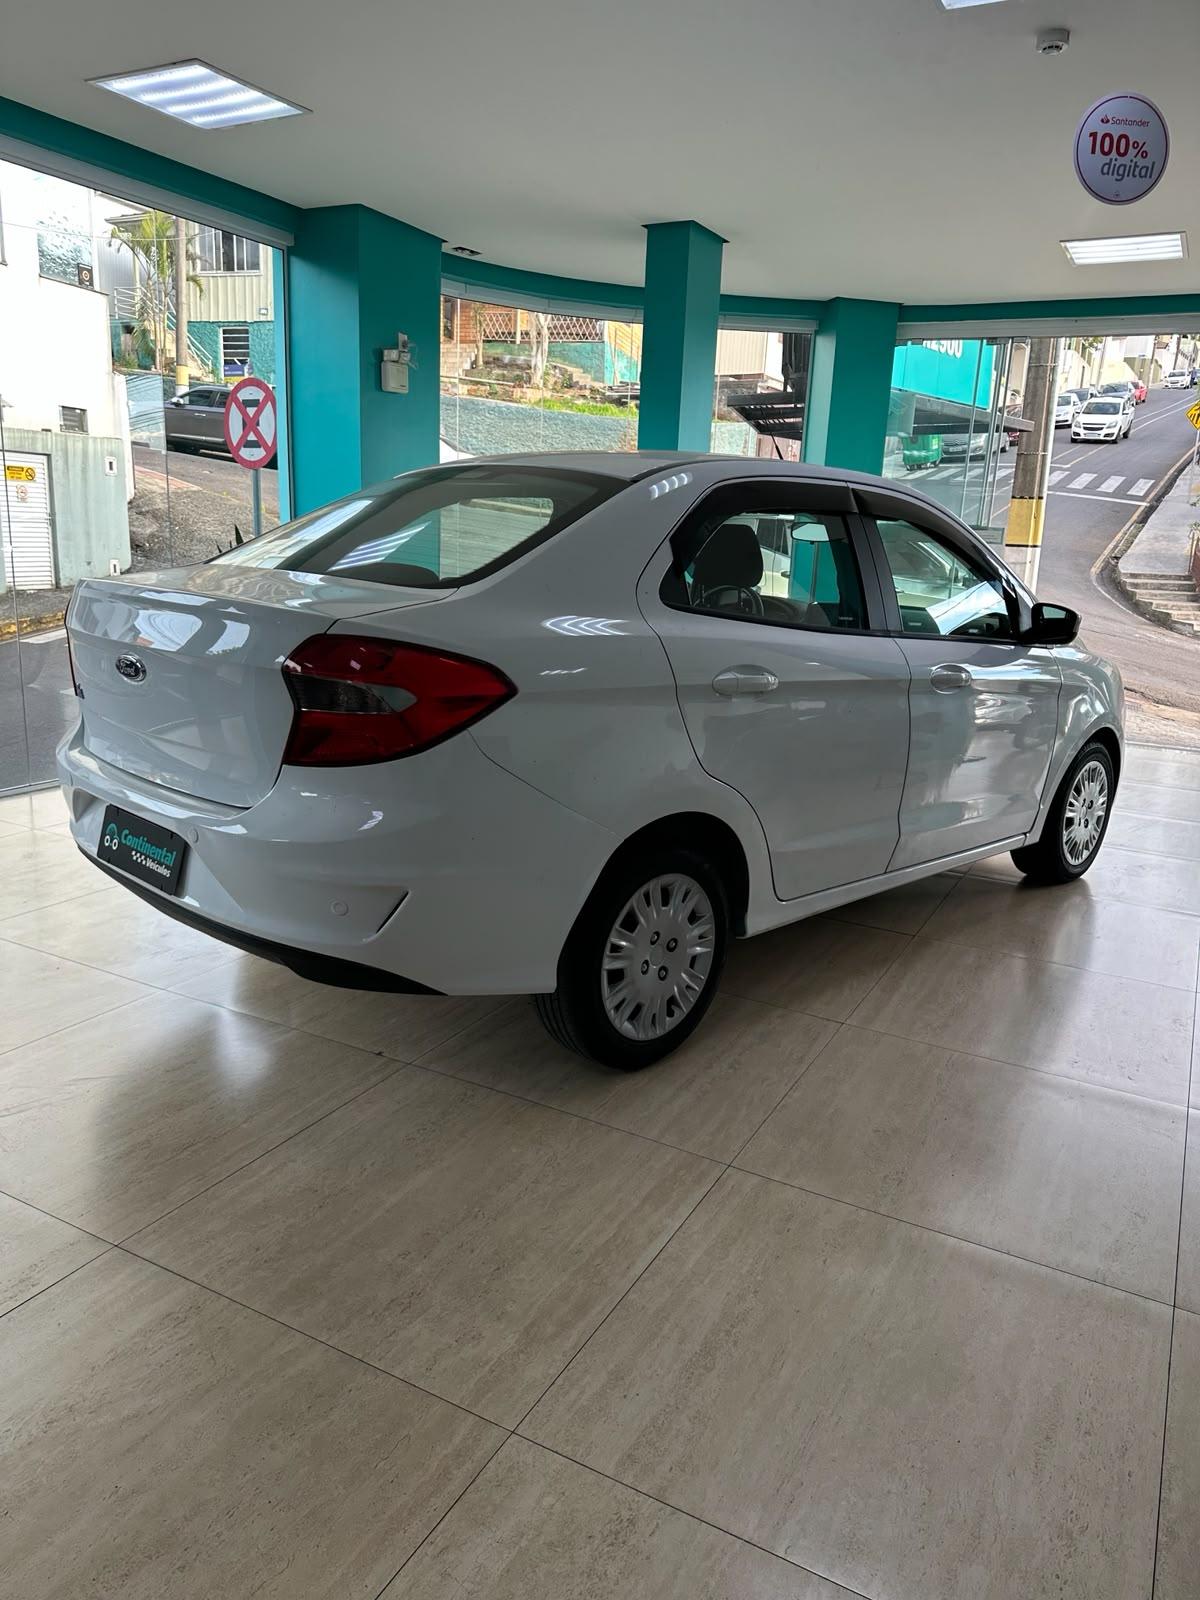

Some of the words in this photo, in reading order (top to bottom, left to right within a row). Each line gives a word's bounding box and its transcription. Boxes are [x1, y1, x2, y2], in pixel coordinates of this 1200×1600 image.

[1111, 116, 1151, 128] Santander
[1088, 131, 1148, 159] 100%
[1100, 158, 1156, 182] digital
[121, 828, 177, 866] Continental
[145, 857, 172, 878] Veículos
